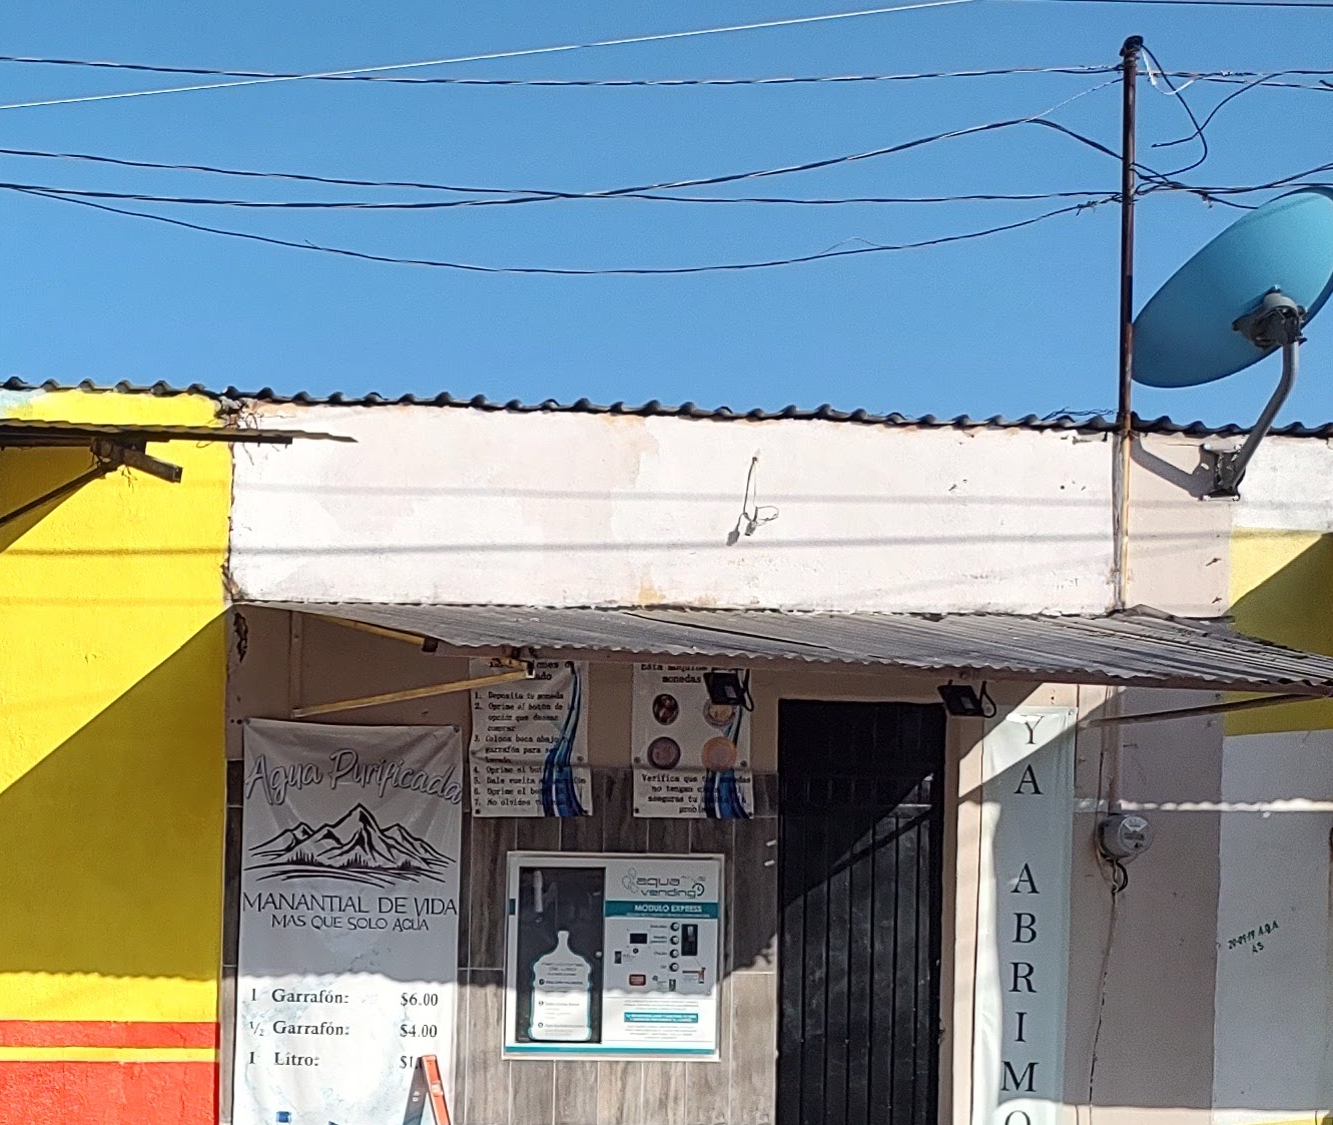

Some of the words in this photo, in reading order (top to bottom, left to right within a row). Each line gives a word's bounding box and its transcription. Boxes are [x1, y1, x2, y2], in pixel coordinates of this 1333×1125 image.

[245, 752, 323, 806] Agua
[327, 747, 463, 805] Purificada
[642, 773, 680, 782] Verifica
[640, 887, 697, 899] vending
[242, 891, 370, 914] MANANTIAL
[377, 896, 408, 914] DE
[413, 897, 458, 917] VIDA
[671, 904, 702, 912] EXPRESS
[271, 913, 307, 929] MAS
[310, 915, 343, 930] QUE
[346, 916, 389, 931] SOLO
[391, 917, 430, 933] AGUA
[271, 988, 349, 1005] Garrafón:
[400, 992, 439, 1007] $6.00
[272, 1020, 350, 1036] Garrafón:
[399, 1024, 438, 1038] $4.00
[274, 1051, 320, 1067] Litro:
